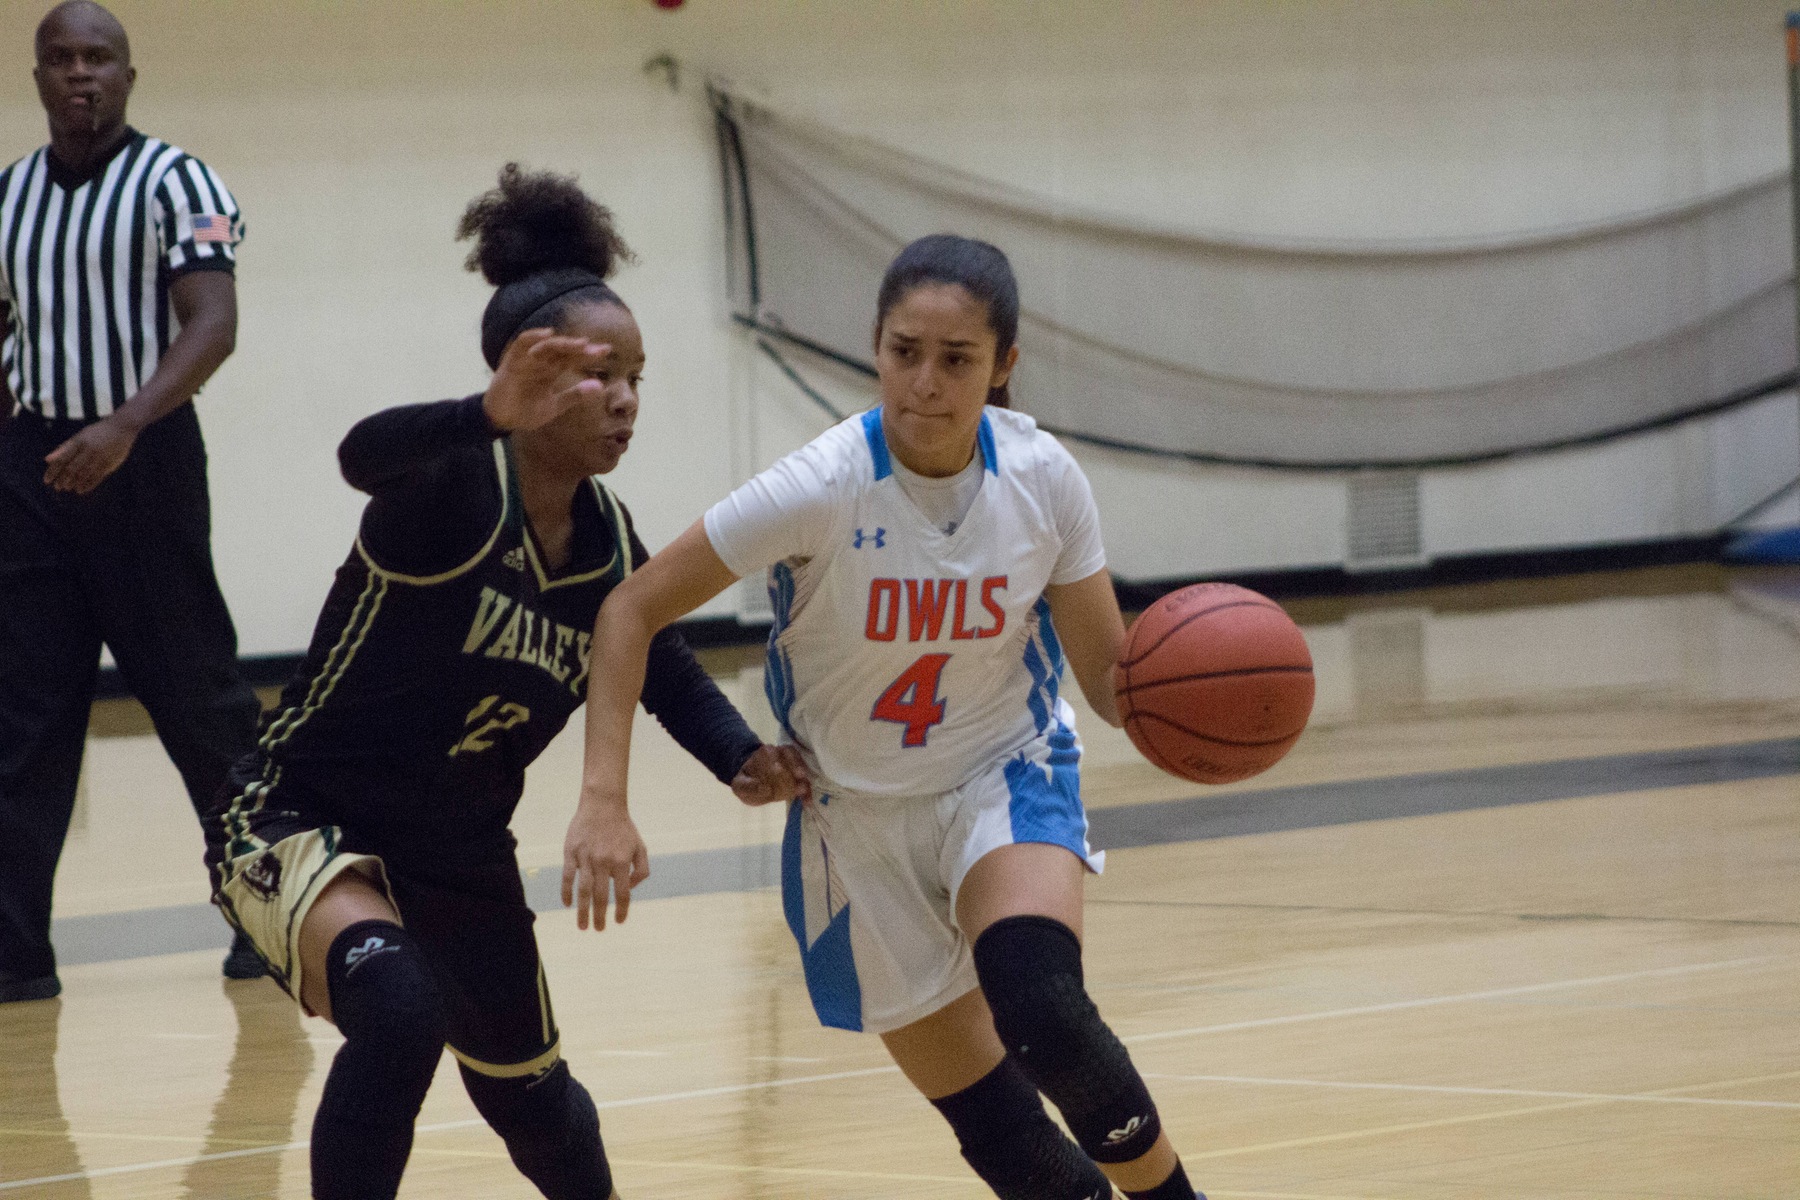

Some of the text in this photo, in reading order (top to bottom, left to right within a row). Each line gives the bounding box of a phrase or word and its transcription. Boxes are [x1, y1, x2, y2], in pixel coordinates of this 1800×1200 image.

[462, 586, 594, 696] VALLEY
[865, 575, 1008, 642] OWLS
[869, 653, 954, 748] 4
